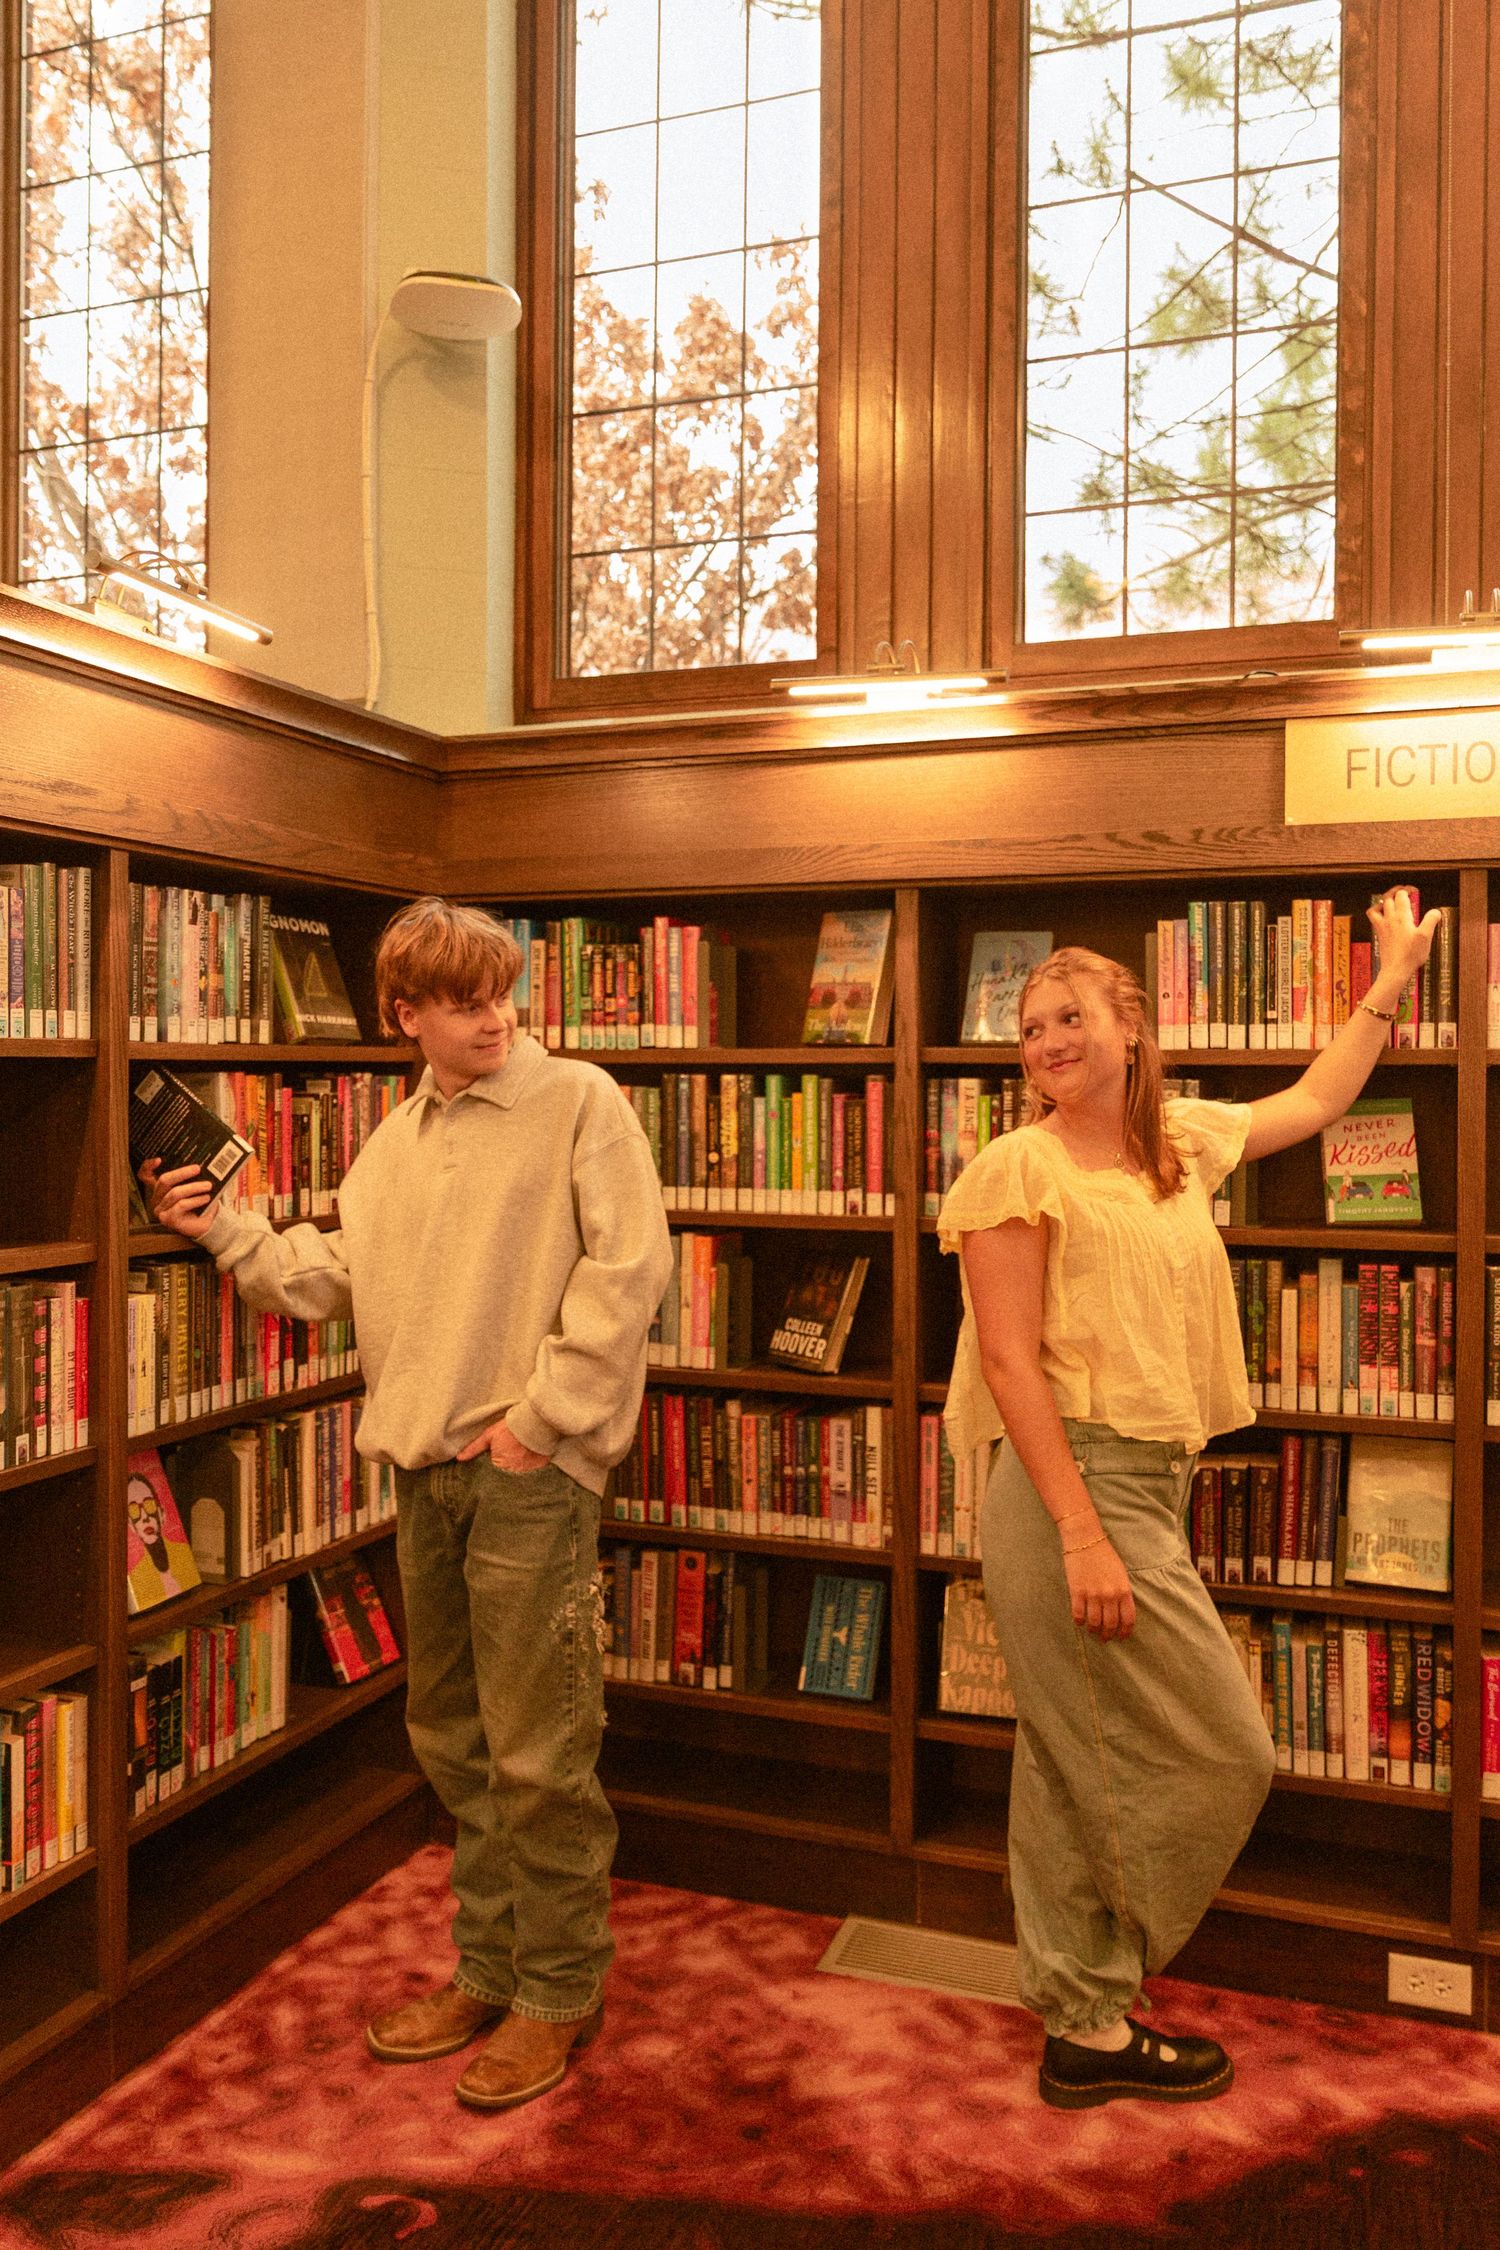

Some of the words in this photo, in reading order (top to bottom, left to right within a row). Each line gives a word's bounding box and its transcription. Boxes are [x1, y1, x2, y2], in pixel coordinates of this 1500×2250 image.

[1346, 740, 1500, 789] FICTIO
[270, 915, 329, 937] GNOMON
[32, 929, 40, 965] Daughter
[243, 942, 251, 982] HARPER
[1281, 996, 1290, 1024] JACKSO
[1343, 1118, 1395, 1134] NEVER
[1356, 1132, 1386, 1142] BEEN
[1325, 1132, 1417, 1168] Kissed
[176, 1268, 188, 1317] TERRY
[1402, 1292, 1411, 1321] Sisters
[1442, 1281, 1453, 1338] MIRRORLAND
[784, 1316, 824, 1337] COLLEEN
[1401, 1328, 1411, 1350] Daisy
[67, 1351, 75, 1364] BY
[176, 1324, 188, 1373] HAYES
[770, 1328, 828, 1360] HOOVER
[67, 1366, 75, 1385] THE
[1402, 1351, 1411, 1387] Johnson
[67, 1387, 75, 1412] BOOK
[866, 1446, 878, 1472] NULL
[866, 1477, 878, 1497] SET
[1284, 1494, 1295, 1531] HENNA
[1388, 1517, 1410, 1534] THE
[1353, 1532, 1441, 1563] PROPHETS
[962, 1598, 999, 1647] Vic
[949, 1644, 1009, 1688] Deep
[1326, 1639, 1339, 1708] DEFECTORS
[1416, 1644, 1432, 1681] RED
[1416, 1683, 1432, 1753] WIDOW
